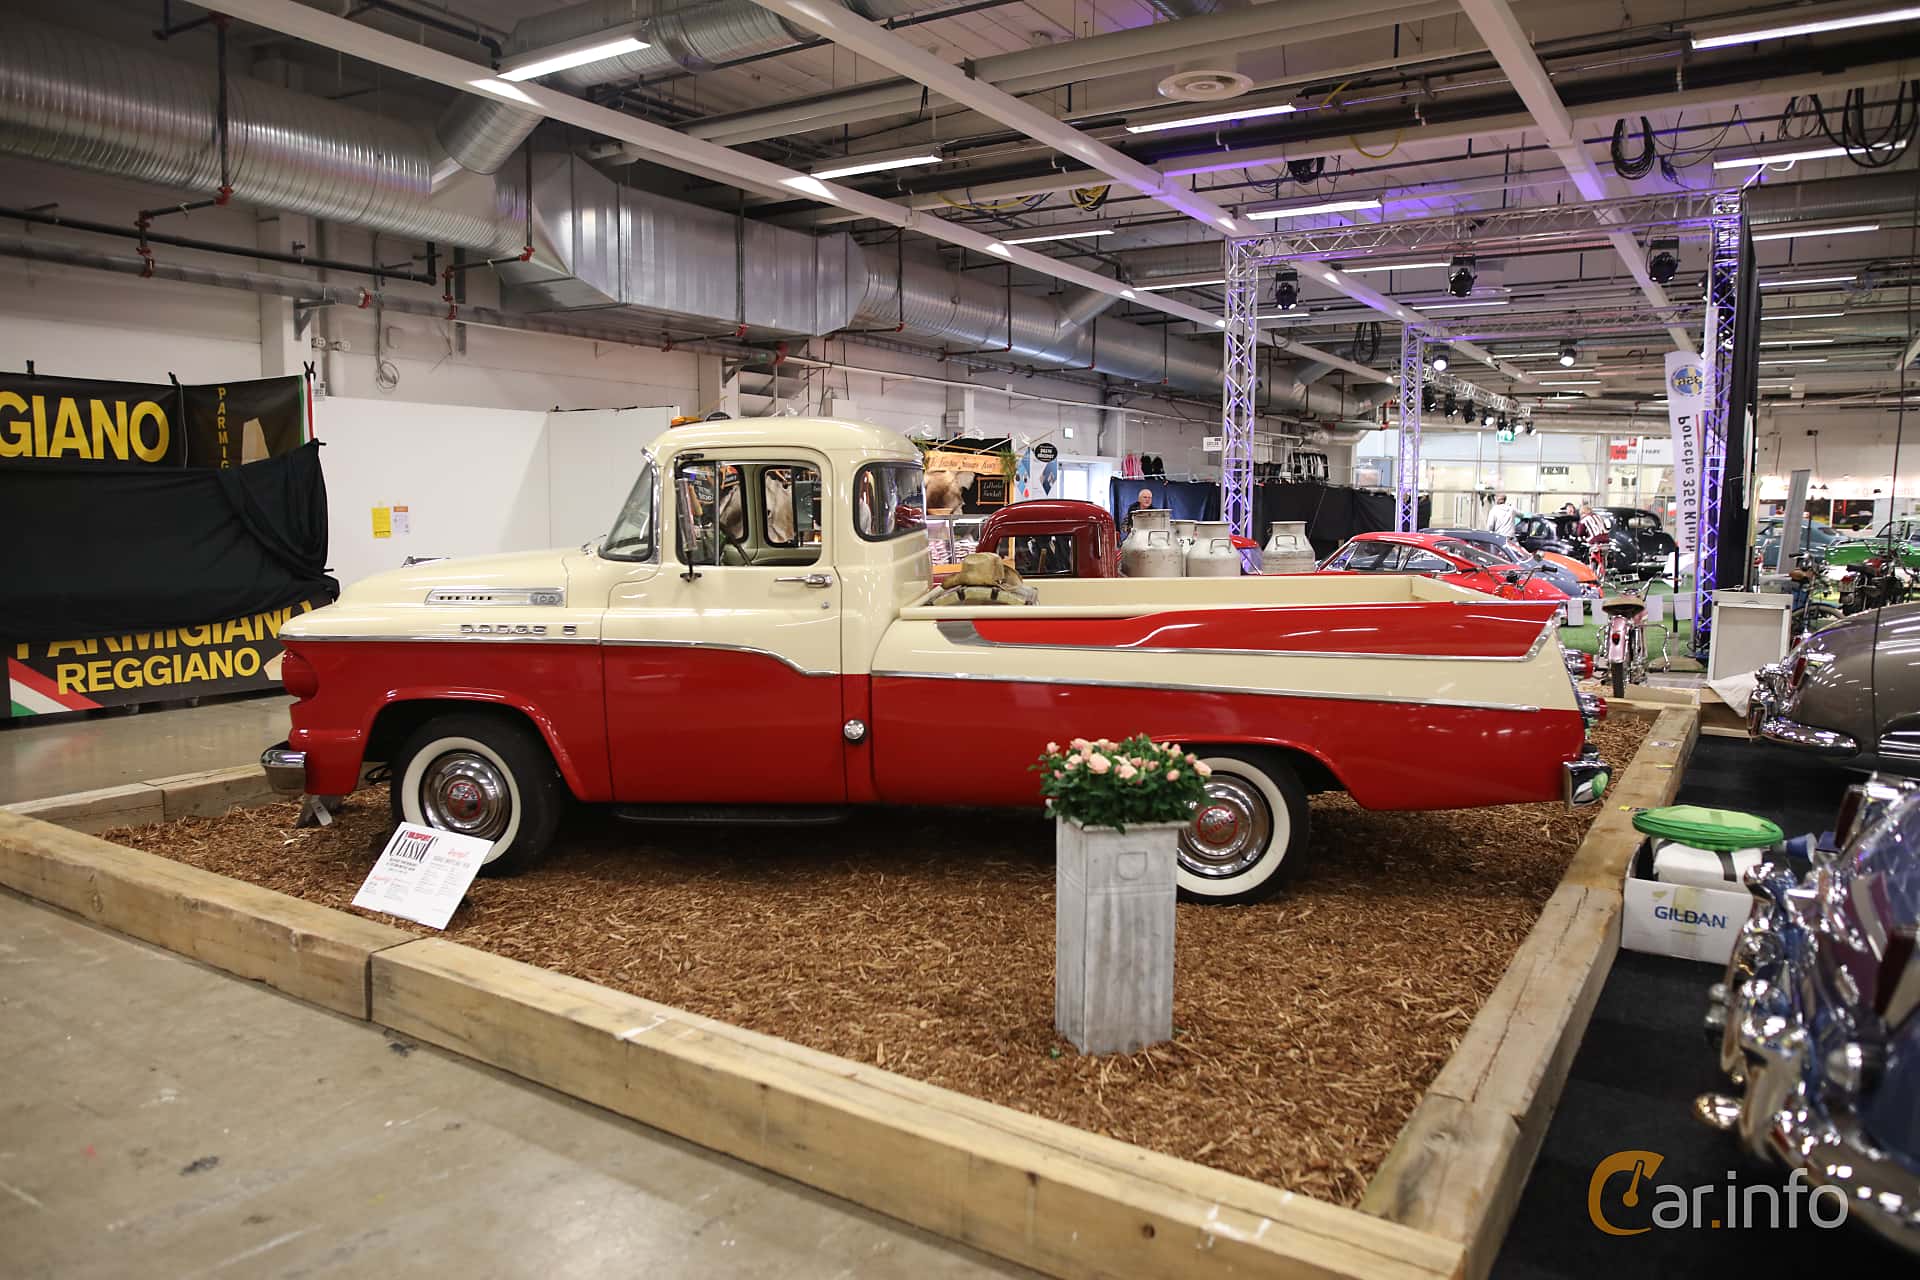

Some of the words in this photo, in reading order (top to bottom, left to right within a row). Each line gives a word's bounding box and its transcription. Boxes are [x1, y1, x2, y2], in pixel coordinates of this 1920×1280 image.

[0, 391, 170, 463] GIANO
[57, 647, 261, 696] REGGIANO
[1654, 905, 1727, 929] GILDAN
